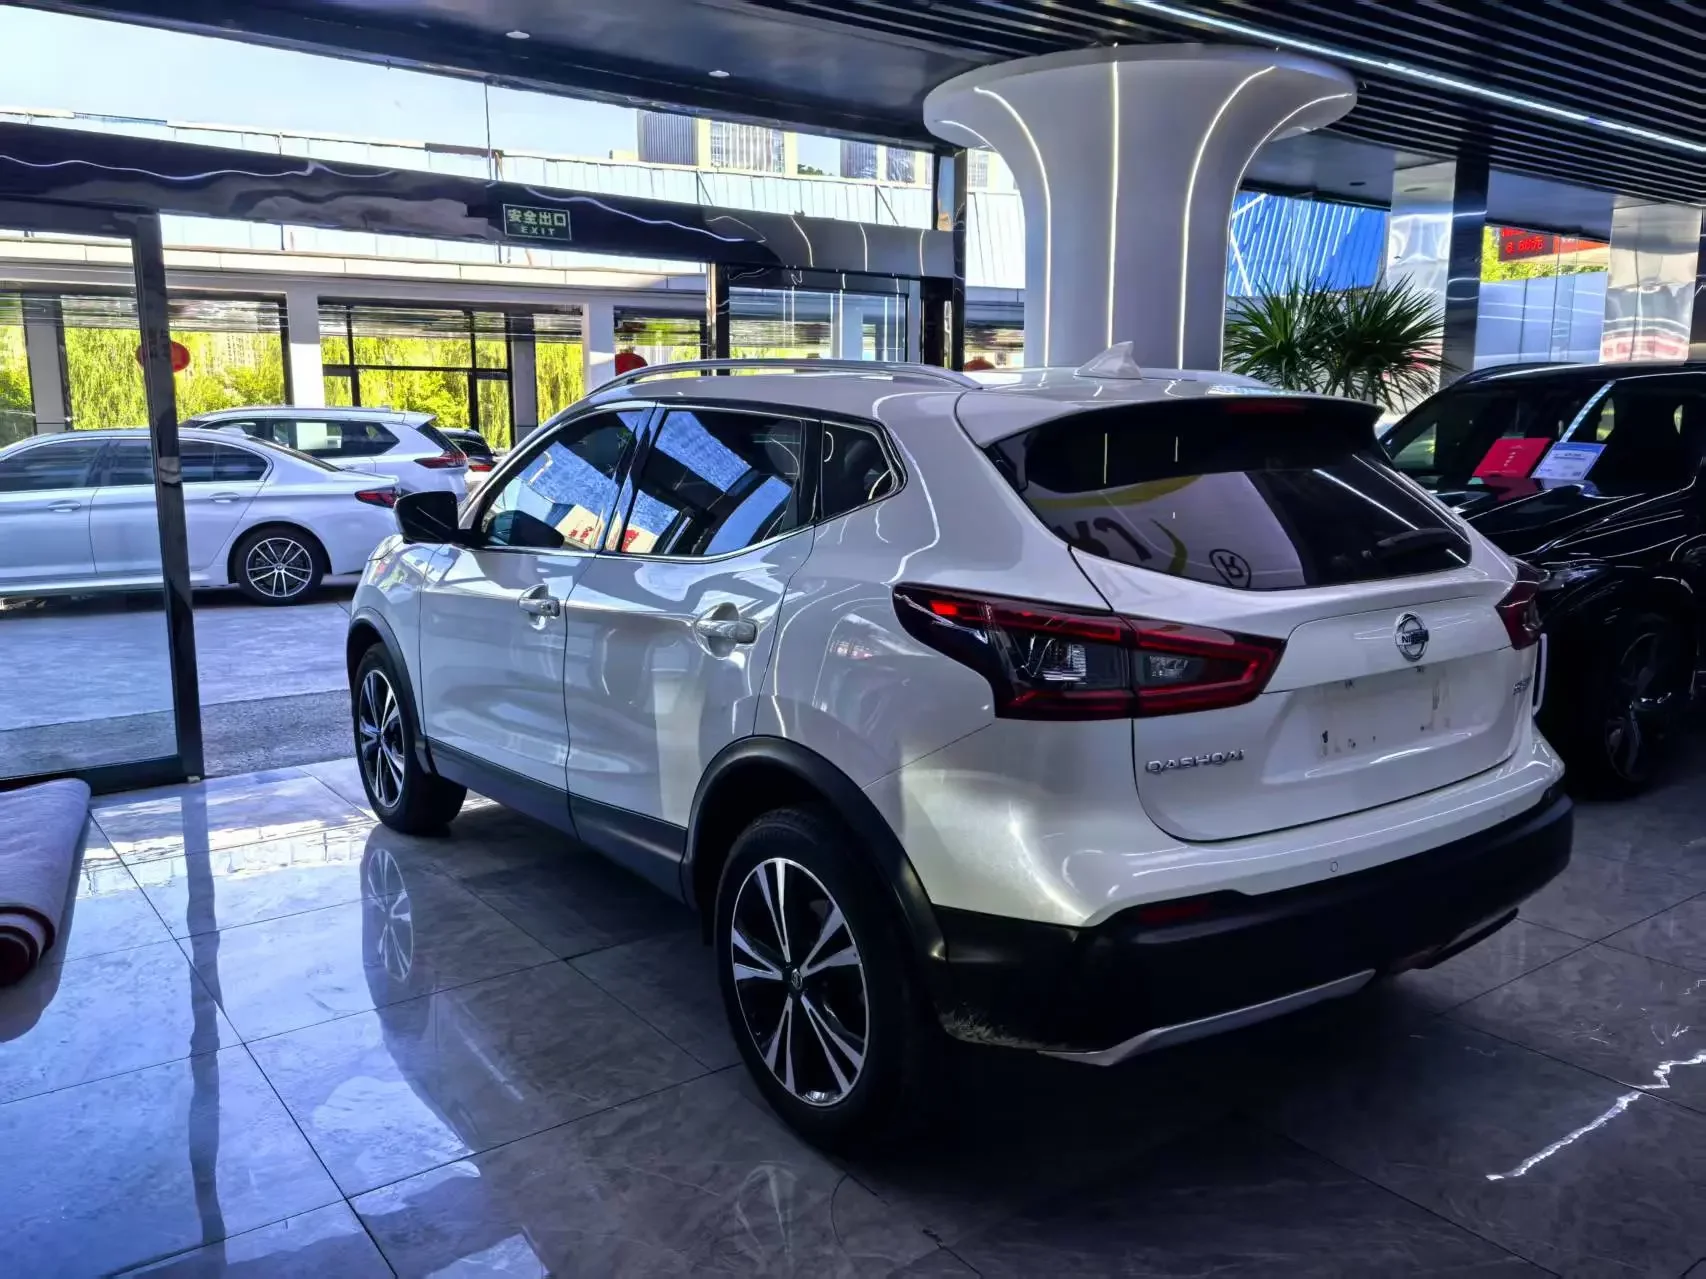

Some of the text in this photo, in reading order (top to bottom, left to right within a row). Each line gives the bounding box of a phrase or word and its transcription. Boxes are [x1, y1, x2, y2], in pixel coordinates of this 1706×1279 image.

[507, 209, 567, 227] 安全出口
[521, 226, 555, 235] EXIT
